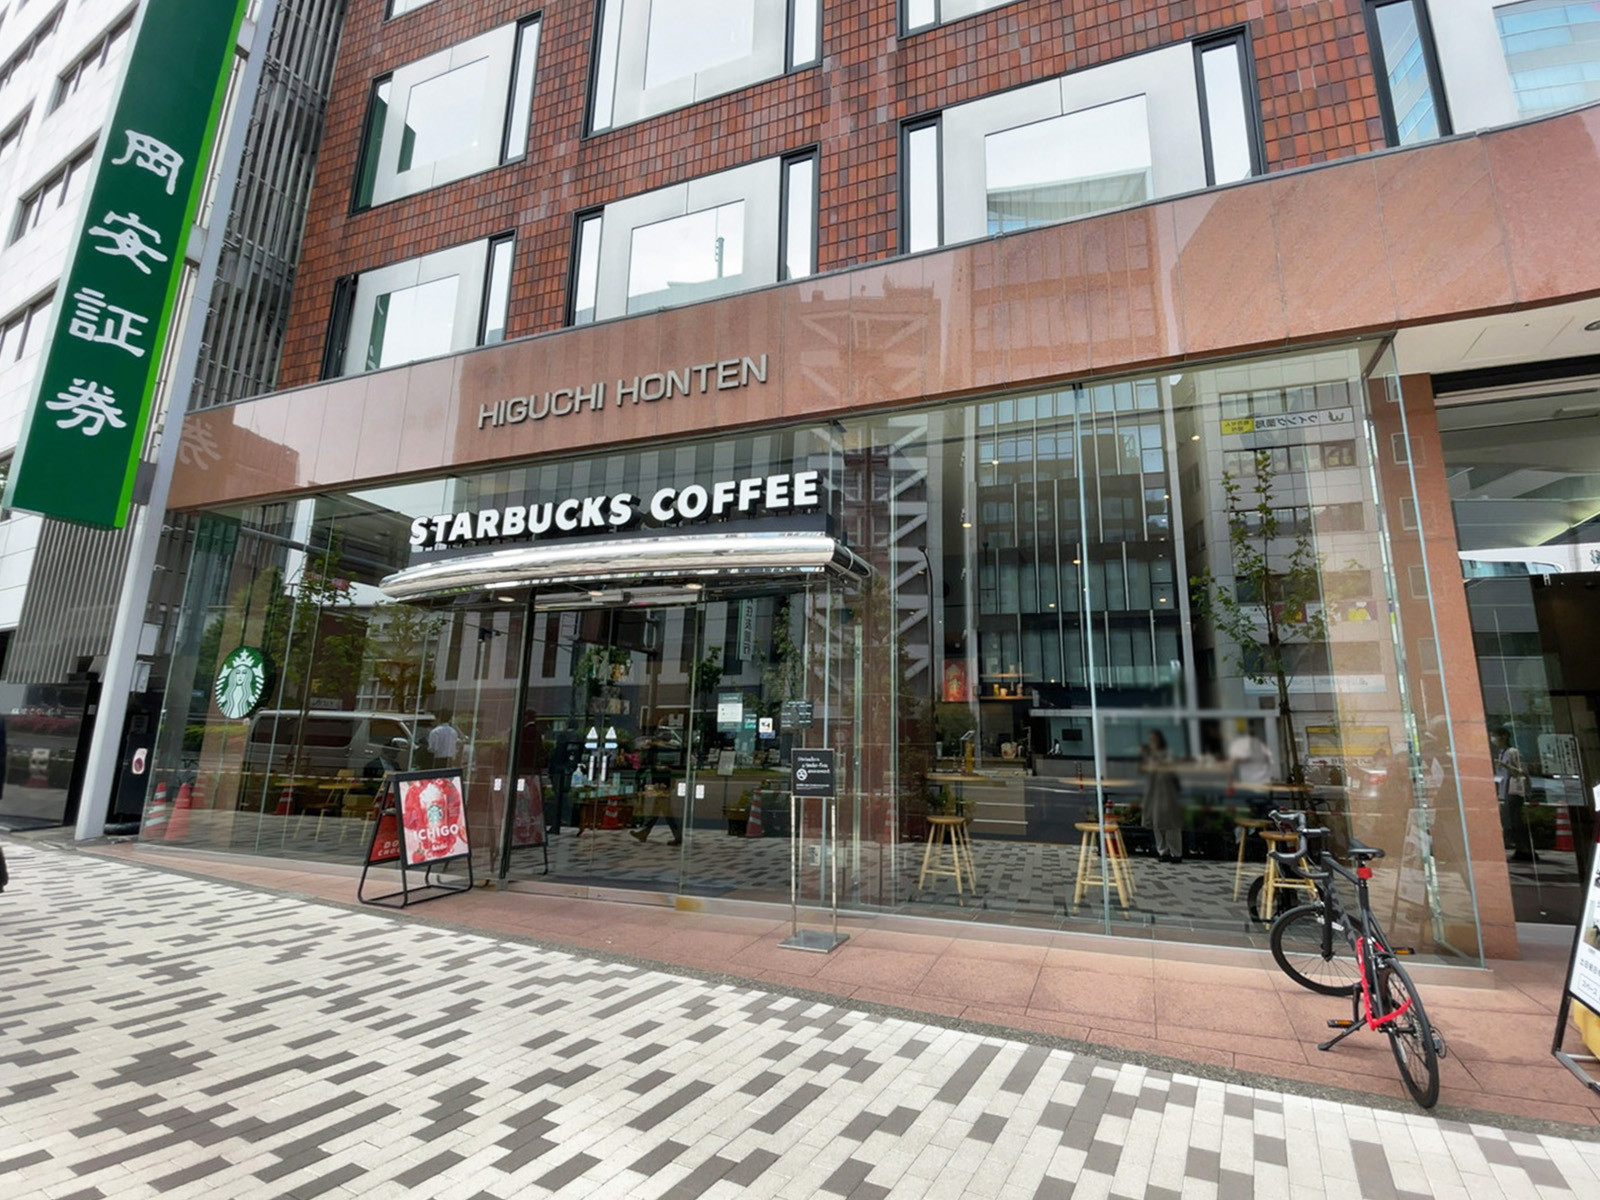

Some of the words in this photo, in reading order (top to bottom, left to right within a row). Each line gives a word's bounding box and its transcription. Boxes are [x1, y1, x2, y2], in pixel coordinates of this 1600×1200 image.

[45, 129, 184, 437] 岡安証券
[477, 382, 607, 429] HIGUCHI
[616, 353, 768, 406] HONTEN
[409, 493, 633, 546] STARBUCKS
[650, 470, 819, 522] COFFEE
[413, 824, 459, 840] ICHIGO
